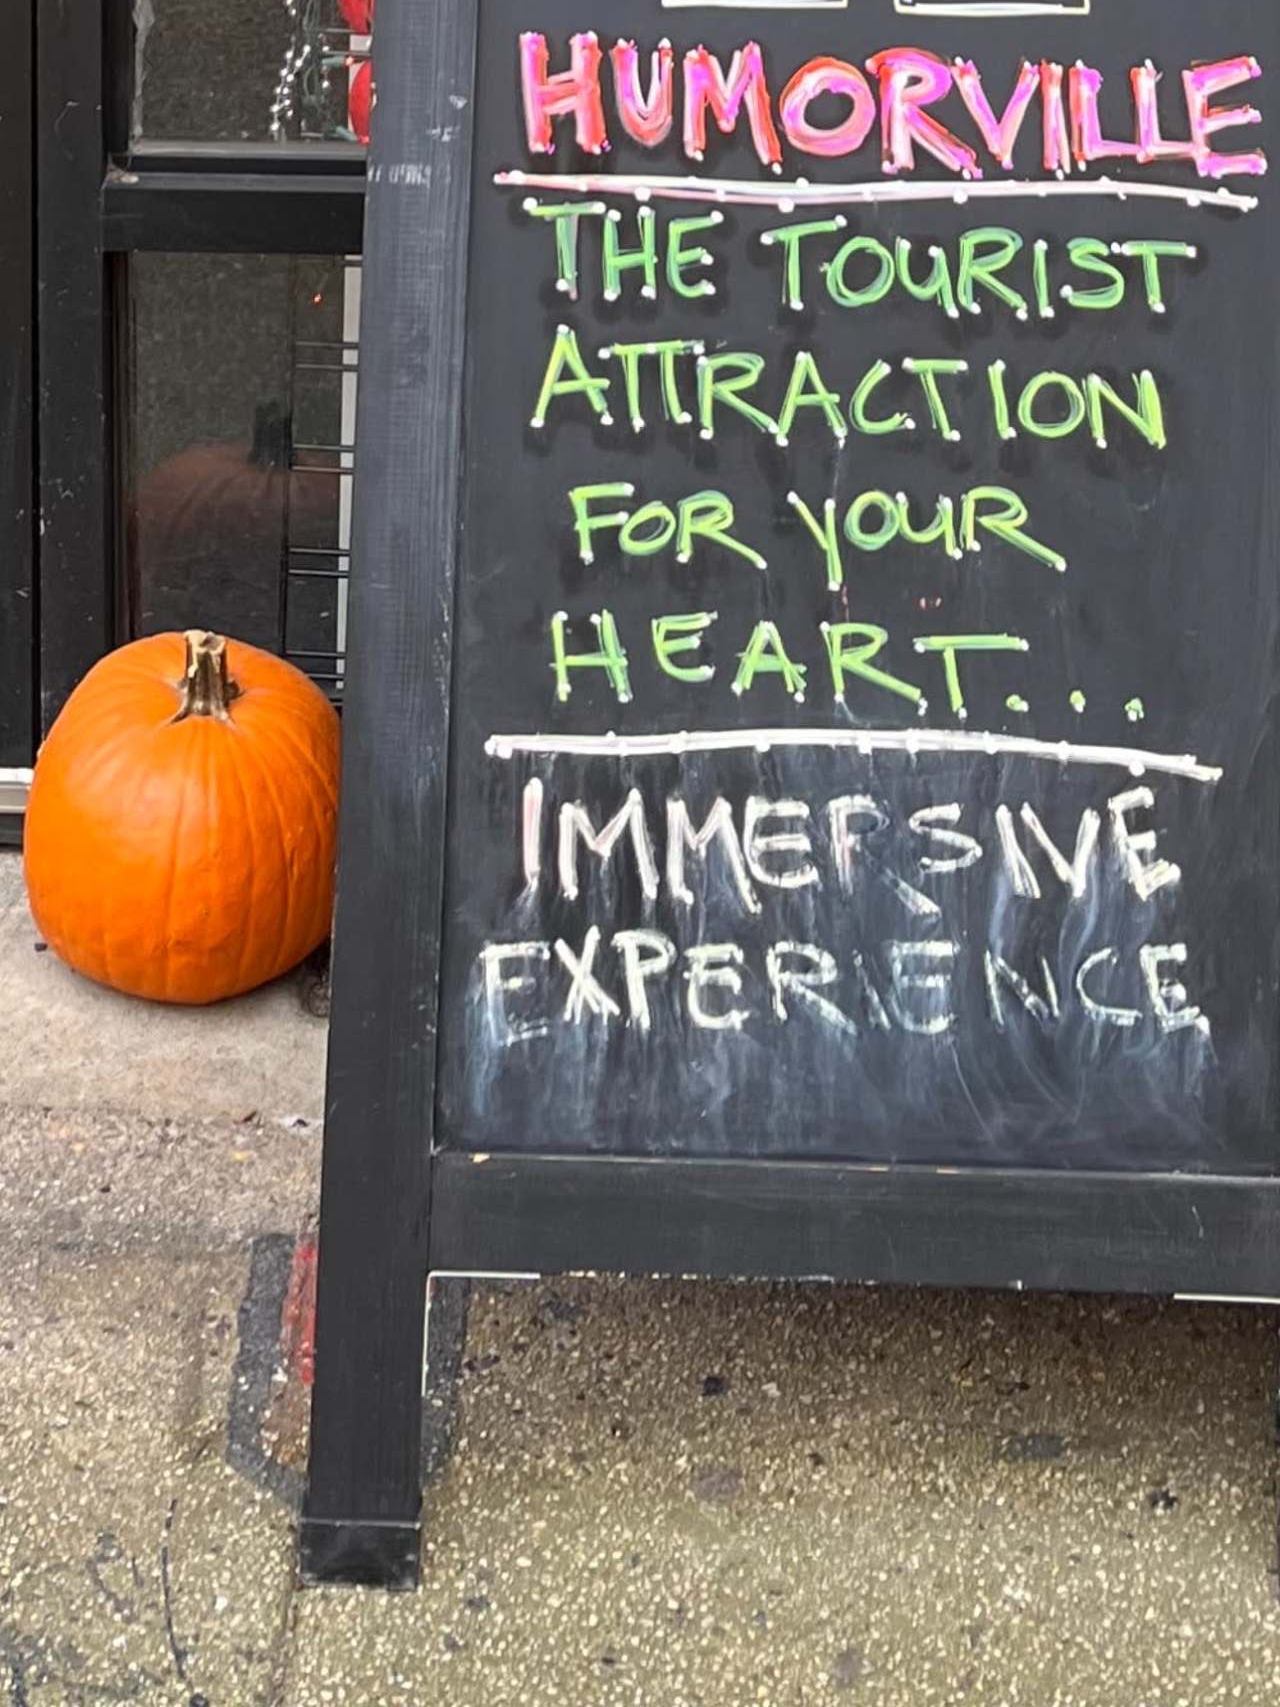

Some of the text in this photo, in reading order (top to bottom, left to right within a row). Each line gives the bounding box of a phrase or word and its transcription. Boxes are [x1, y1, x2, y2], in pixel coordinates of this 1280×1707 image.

[519, 32, 1269, 179] HUMORVILLE
[522, 197, 1198, 320] THE TOURIST
[530, 323, 1166, 449] ATTRACTION
[568, 482, 1067, 593] FOR YOUR
[520, 777, 1182, 917] IMMERSIVE
[476, 925, 1212, 1047] EXPERIENCE
